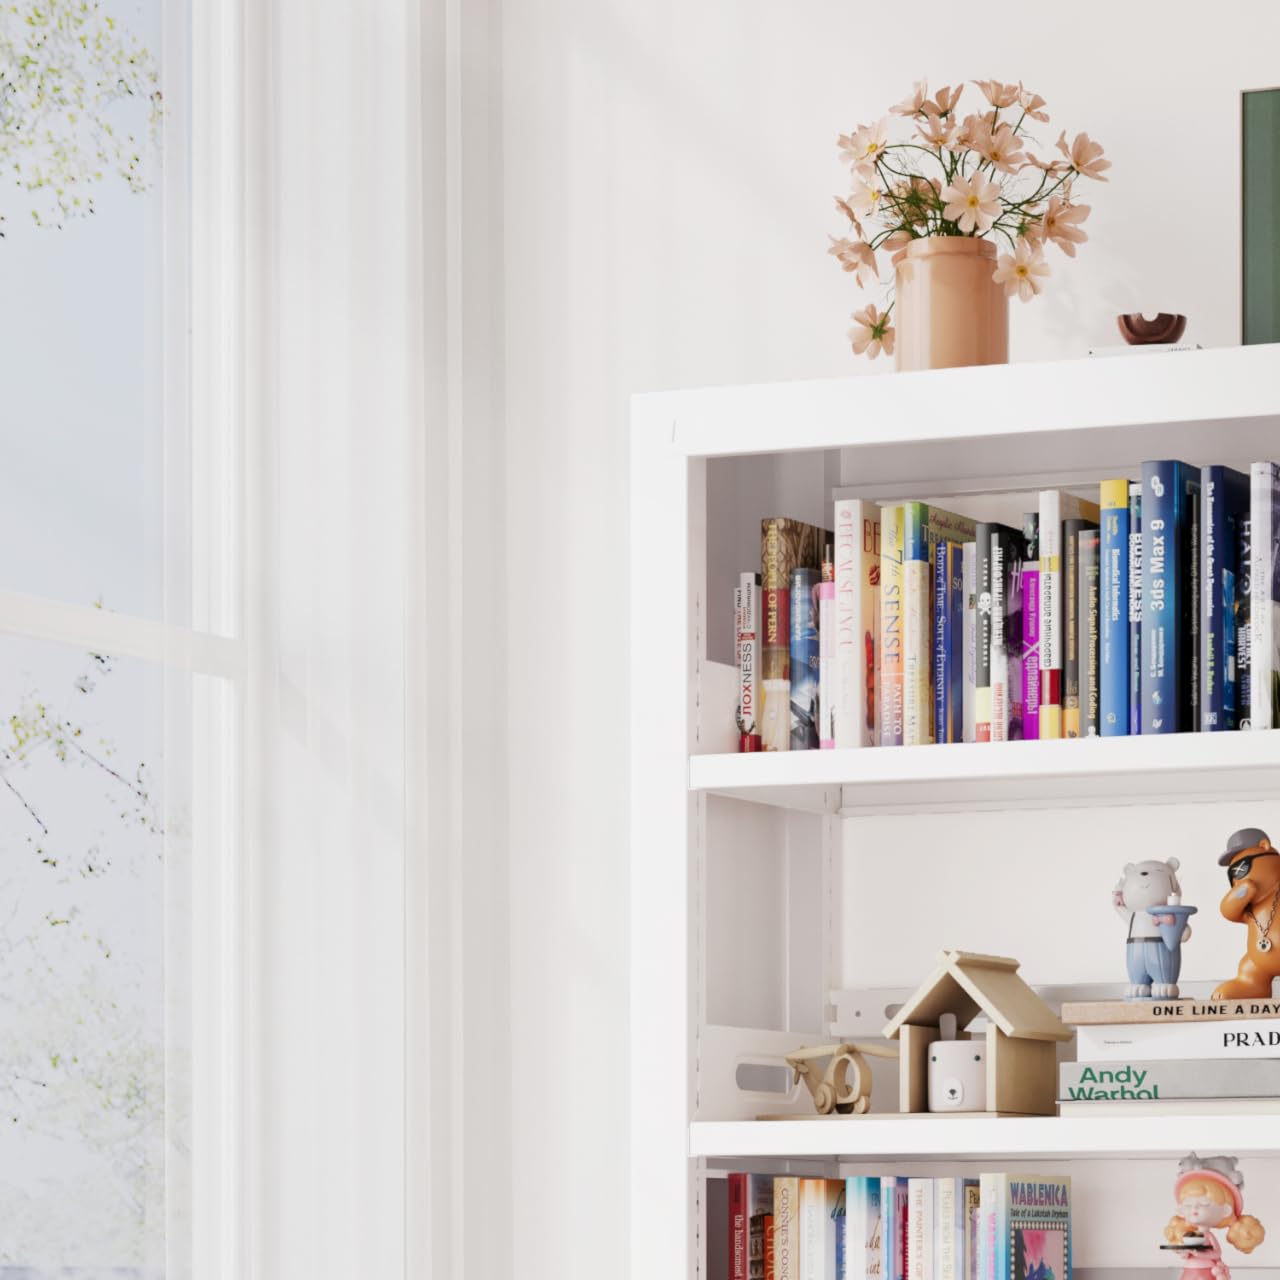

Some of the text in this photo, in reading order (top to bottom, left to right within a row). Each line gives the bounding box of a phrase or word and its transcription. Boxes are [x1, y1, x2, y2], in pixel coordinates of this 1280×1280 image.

[1150, 519, 1164, 531] 9
[1111, 549, 1120, 584] Biomedical
[1150, 536, 1164, 574] Max
[1043, 573, 1053, 617] аппараты
[1087, 586, 1098, 608] Audio
[1111, 585, 1120, 621] Informatics
[1150, 579, 1164, 611] 3ds
[884, 585, 900, 664] SENSE
[937, 547, 946, 702] BODY SOUL ETERNITY
[1087, 608, 1098, 634] Signal
[1087, 635, 1098, 676] Processing
[1237, 627, 1246, 669] HARVEST
[1087, 692, 1098, 719] Coding
[1153, 1005, 1184, 1017] ONE
[1192, 1004, 1228, 1016] LINE
[1235, 1005, 1246, 1015] A
[1079, 1065, 1148, 1088] Andy
[1067, 1084, 1160, 1101] Warhol
[915, 1188, 924, 1209] THE
[1010, 1182, 1068, 1206] WABLENICA
[734, 1214, 743, 1229] the
[734, 1230, 743, 1277] handsomest
